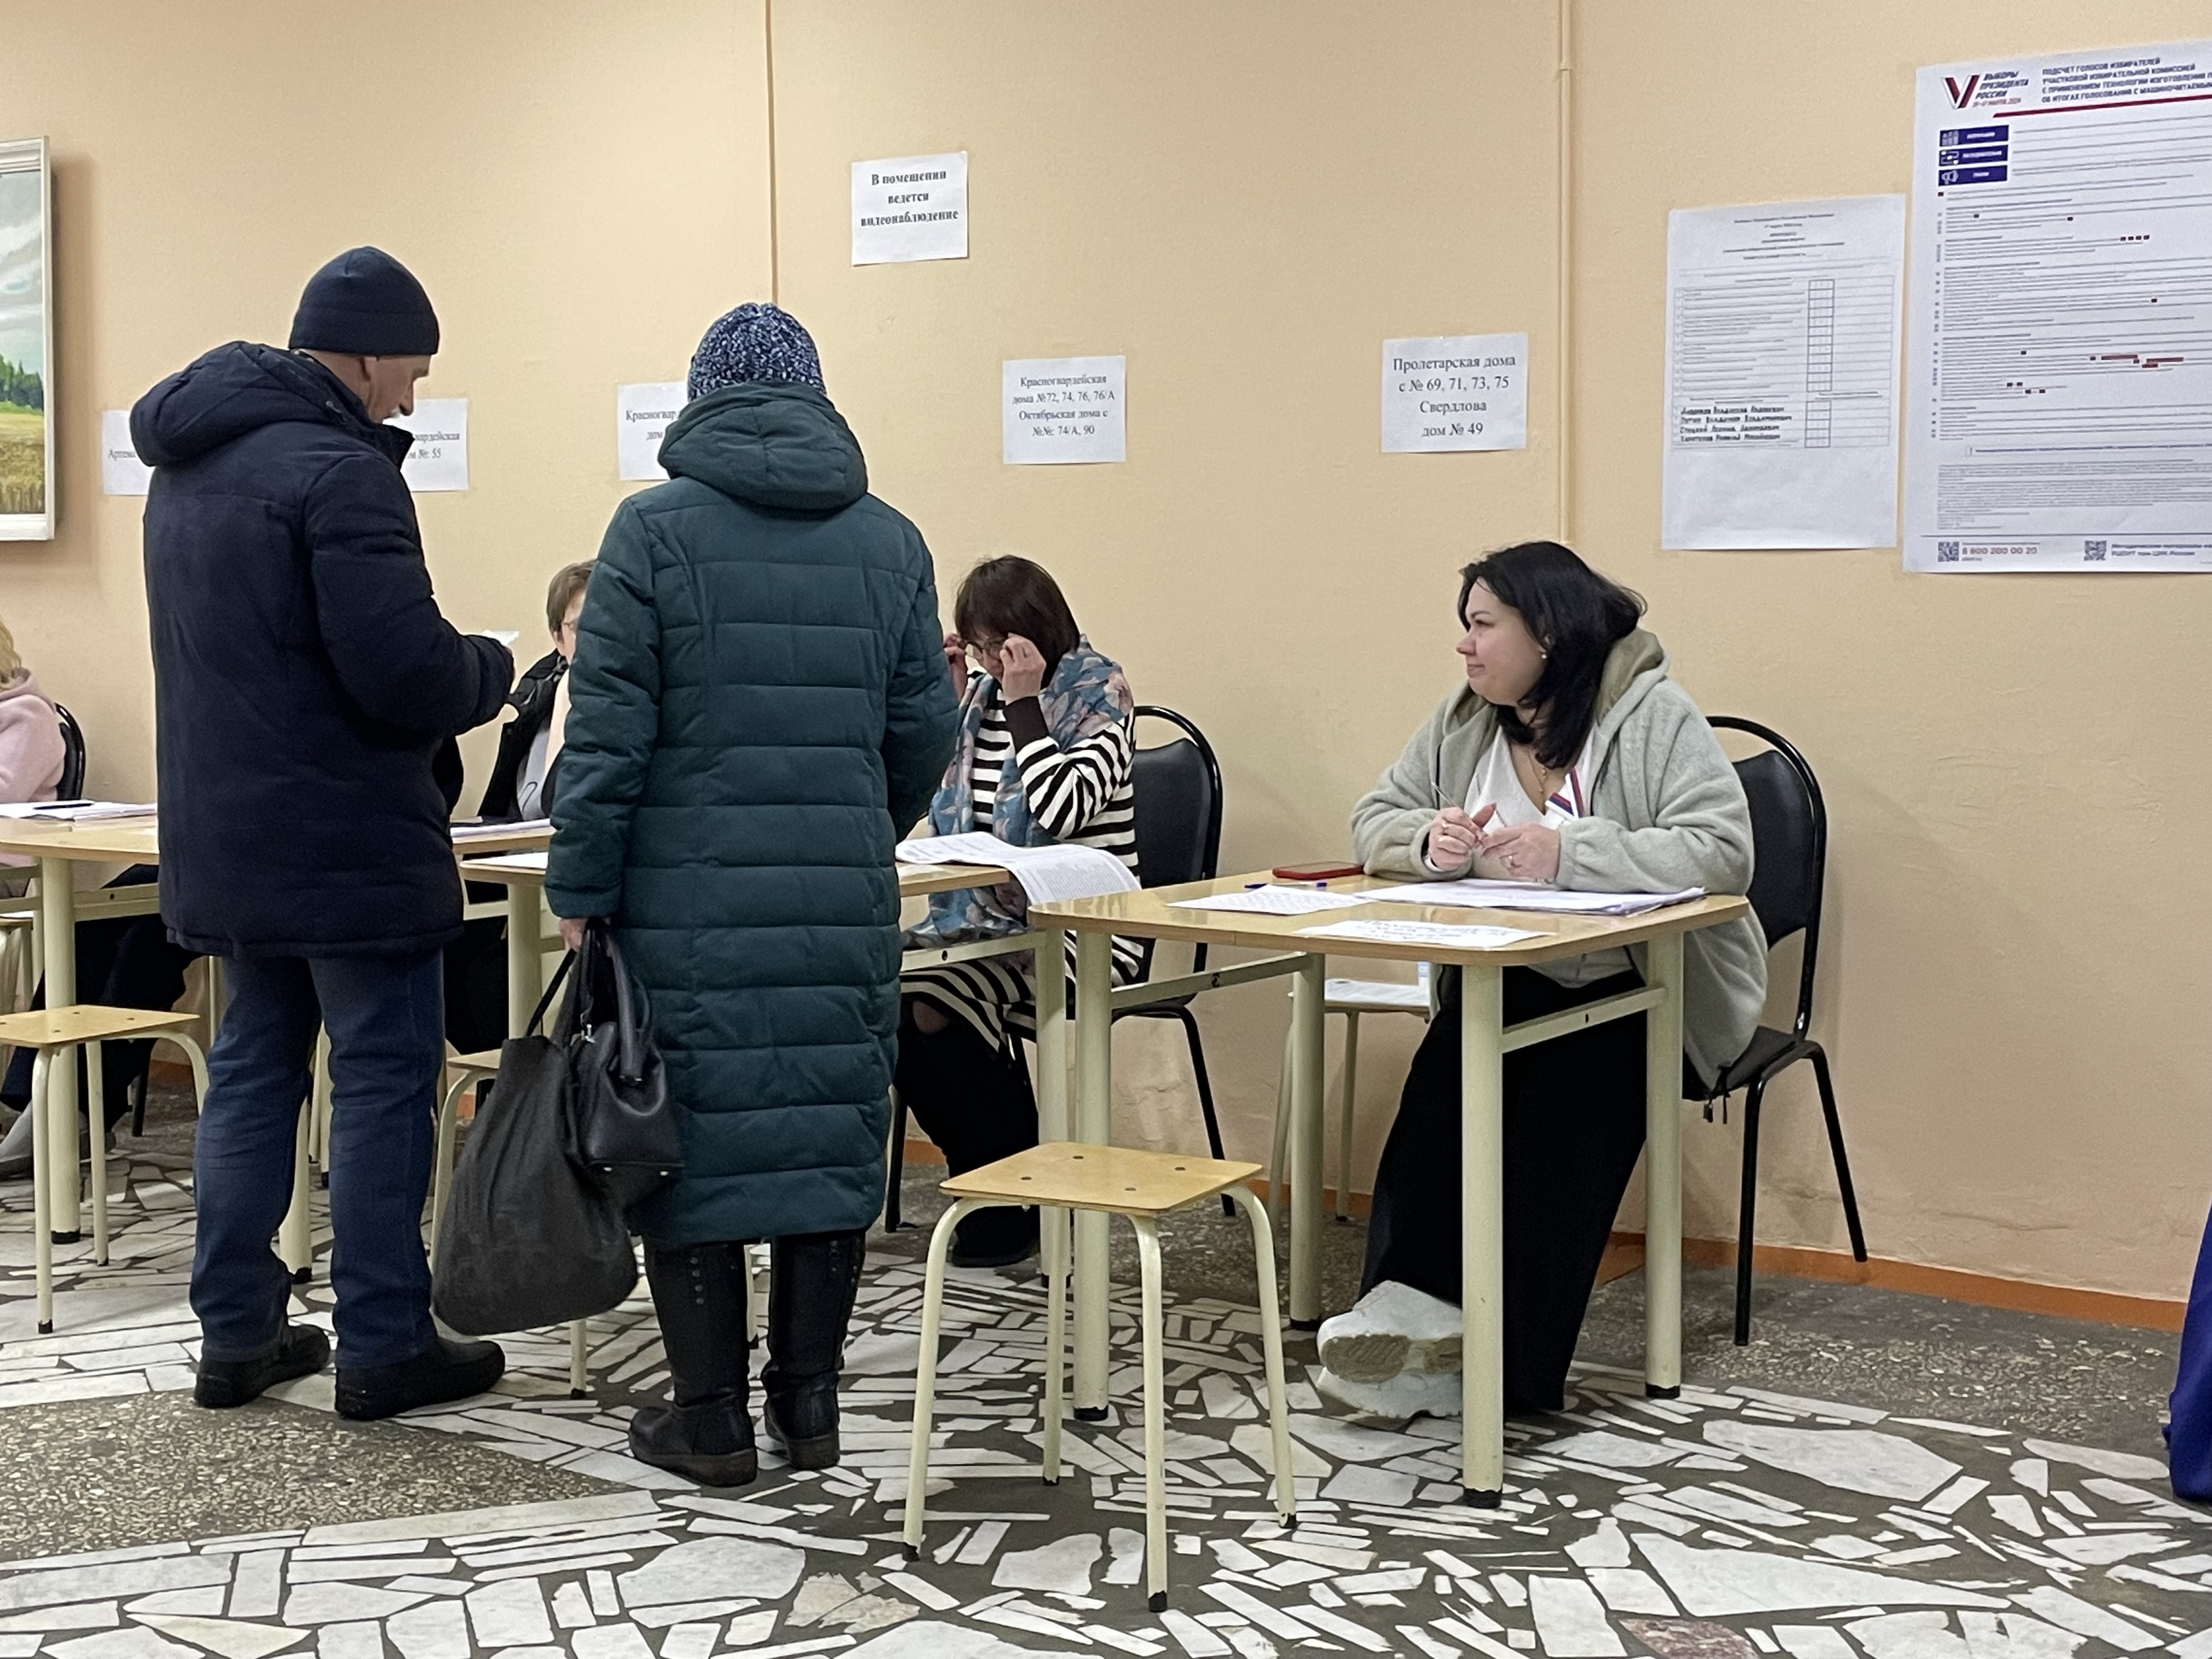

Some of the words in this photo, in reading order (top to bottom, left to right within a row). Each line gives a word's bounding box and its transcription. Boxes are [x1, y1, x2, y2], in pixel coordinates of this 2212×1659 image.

[871, 174, 879, 185] В
[882, 171, 946, 184] помещении
[888, 193, 929, 204] ведется
[861, 210, 959, 227] видеонаблюдение
[1393, 358, 1480, 374] Пролетарская
[1483, 356, 1516, 368] дома
[1020, 374, 1107, 389] Красногвардейская
[1398, 383, 1405, 392] с
[1409, 379, 1424, 392] №
[1426, 377, 1445, 393] 69,
[1449, 377, 1467, 391] 71,
[1471, 376, 1490, 391] 73,
[1494, 375, 1509, 388] 75
[1012, 396, 1034, 405] дома
[1420, 400, 1486, 415] Свердлова
[1019, 410, 1075, 421] Октябрьская
[1077, 410, 1101, 419] дома
[1084, 425, 1095, 435] 90
[1421, 426, 1446, 437] дом
[1449, 423, 1464, 436] №
[1467, 422, 1483, 435] 49
